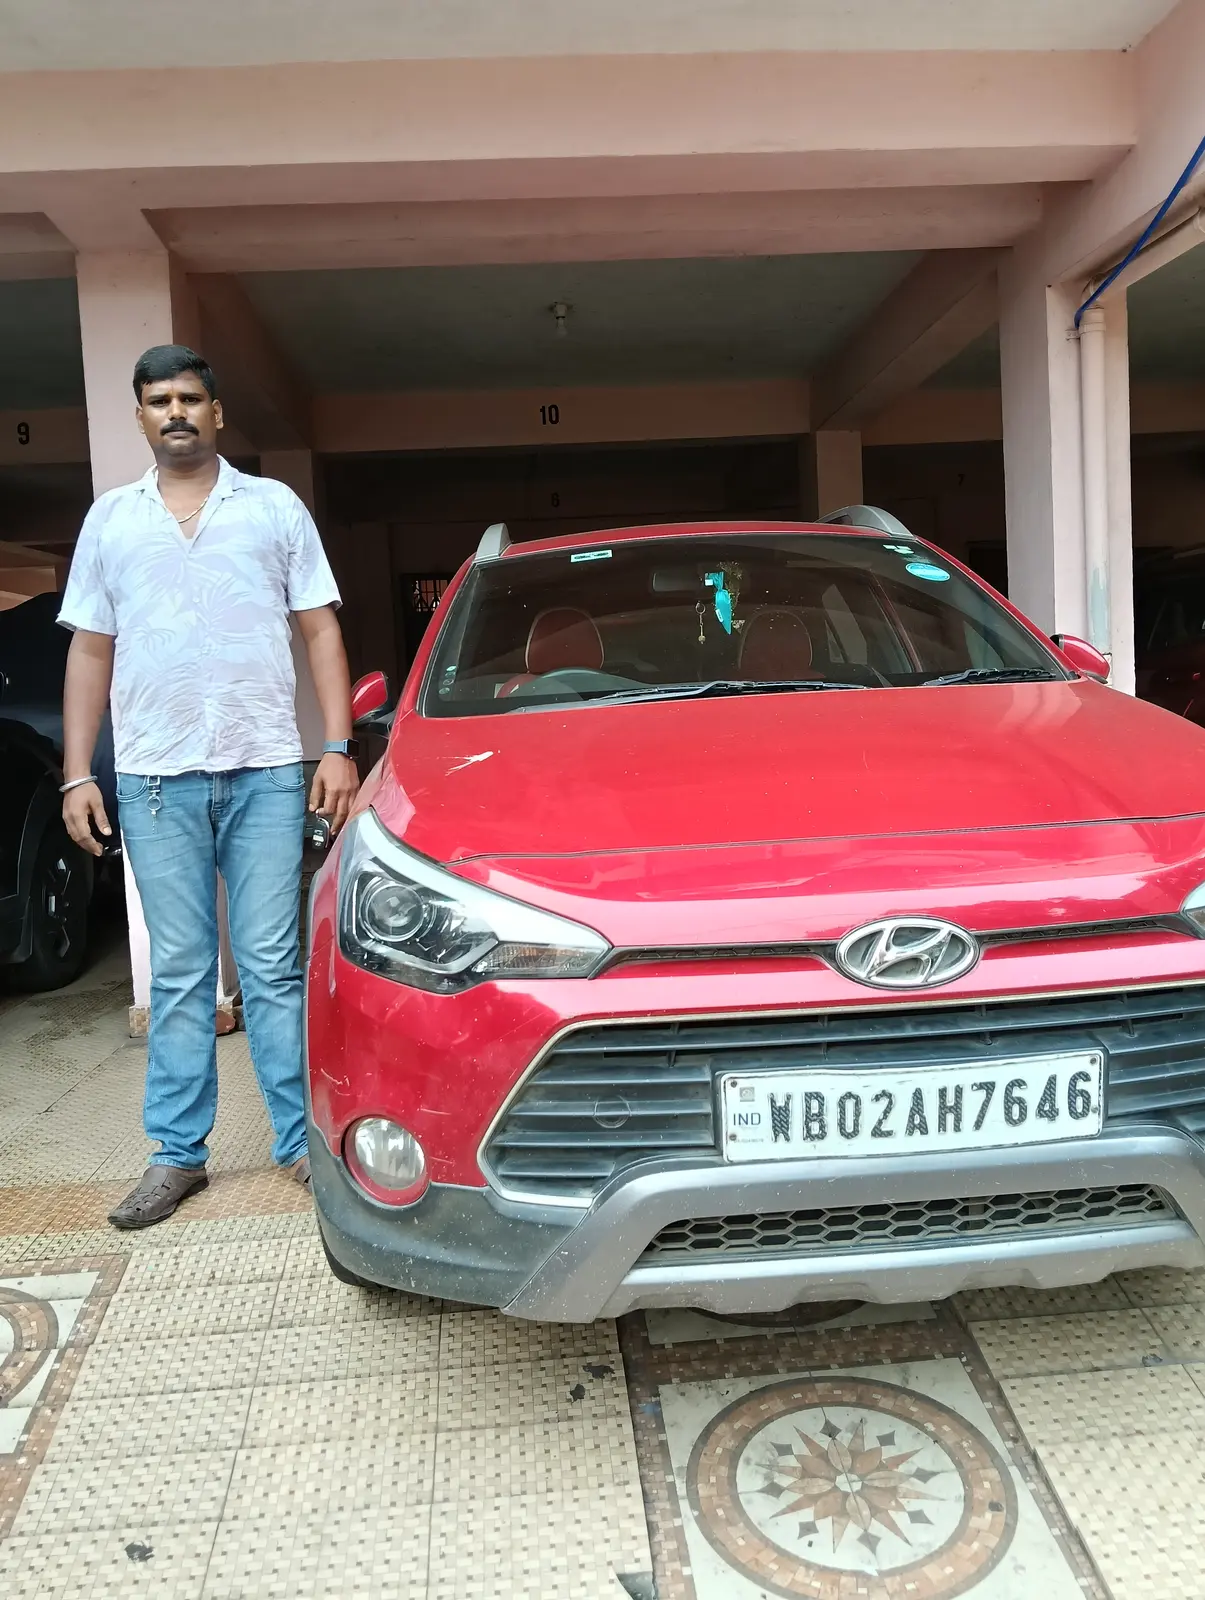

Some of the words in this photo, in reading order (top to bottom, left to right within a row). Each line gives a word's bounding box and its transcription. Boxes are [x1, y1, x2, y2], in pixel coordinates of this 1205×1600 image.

[539, 404, 560, 425] 10
[17, 422, 30, 446] 9
[768, 1070, 1093, 1143] WB02AH7646
[733, 1112, 761, 1126] IND
